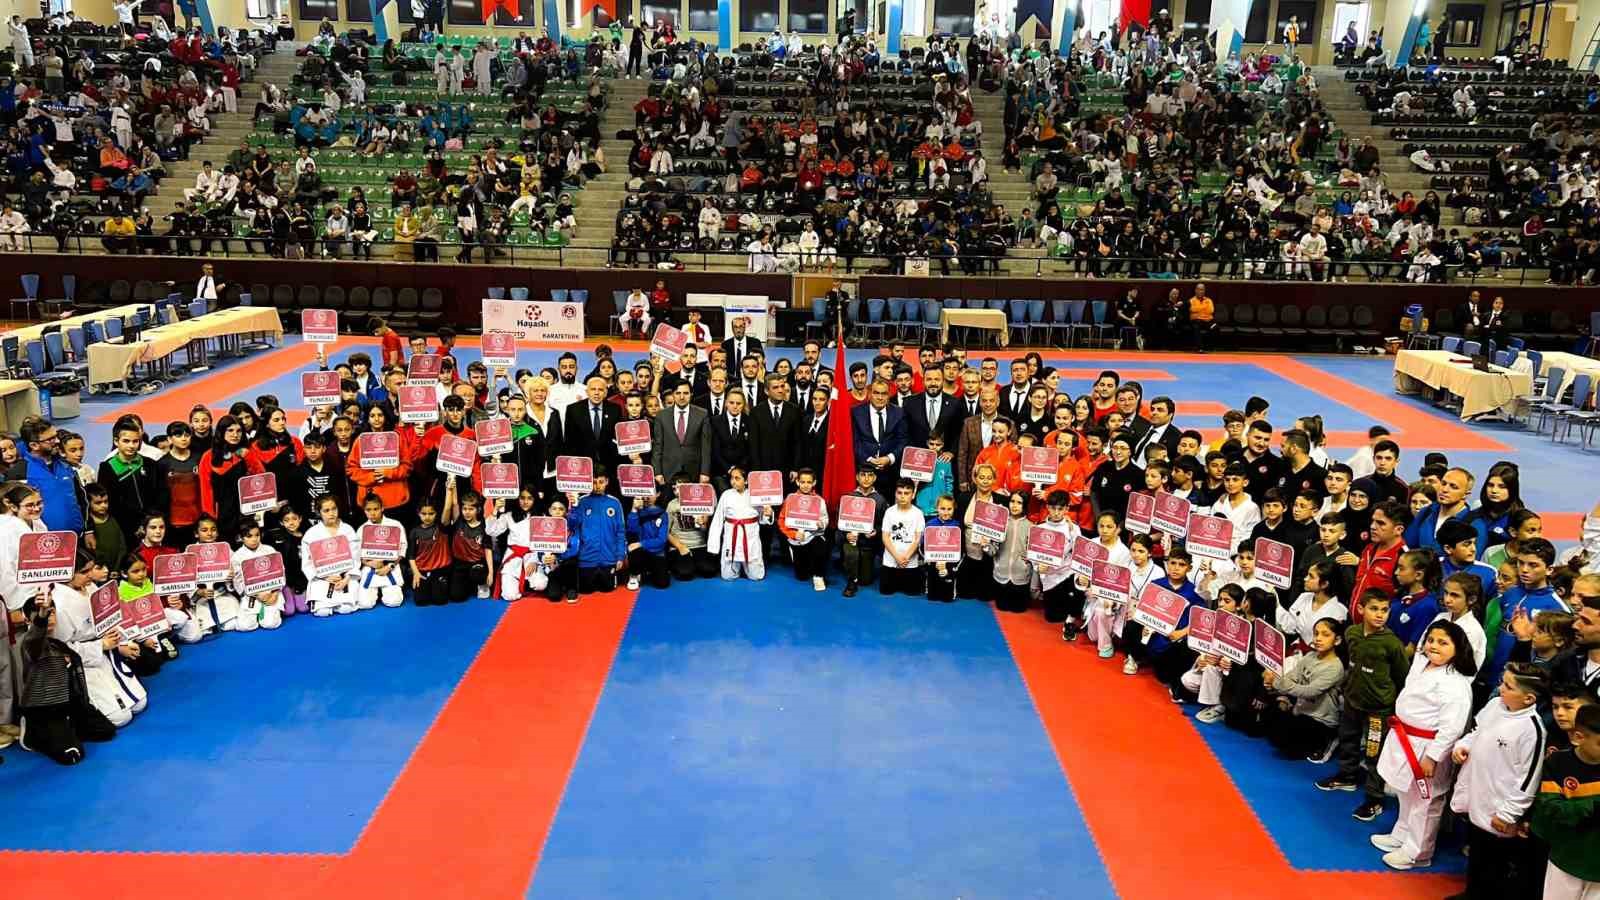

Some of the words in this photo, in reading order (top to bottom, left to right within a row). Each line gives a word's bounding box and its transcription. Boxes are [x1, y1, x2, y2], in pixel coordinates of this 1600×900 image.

[517, 319, 549, 328] Hayashi
[1262, 572, 1281, 583] ADANA
[161, 583, 190, 591] SAMSUN
[1099, 589, 1120, 599] BURSA
[1217, 644, 1240, 658] ANKARA
